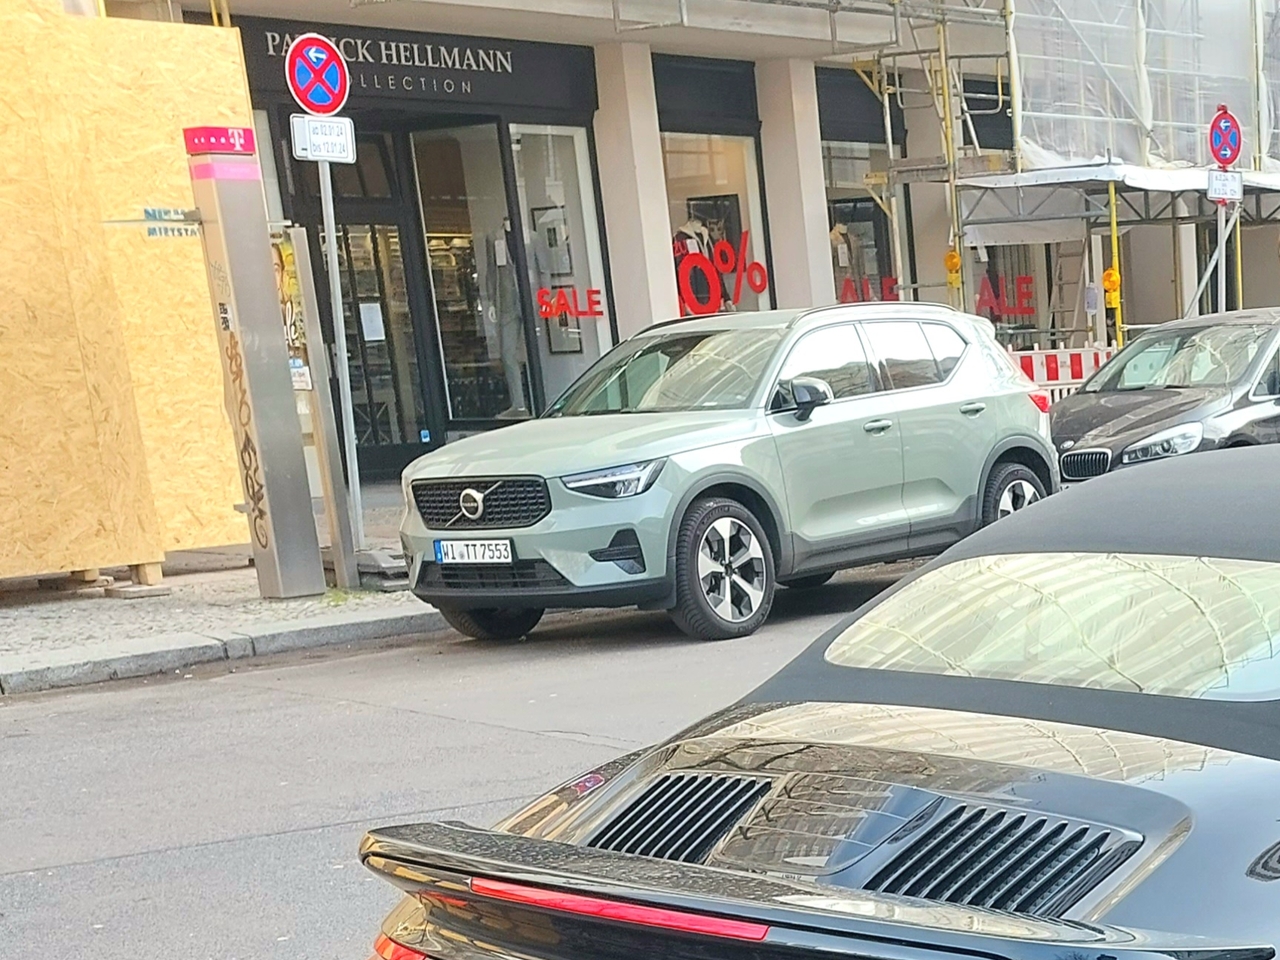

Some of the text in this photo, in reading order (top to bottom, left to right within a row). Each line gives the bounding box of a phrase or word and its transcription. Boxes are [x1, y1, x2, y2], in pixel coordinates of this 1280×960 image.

[380, 41, 513, 74] HELLMANN
[349, 75, 472, 94] LLECTION
[536, 287, 604, 318] SALE
[976, 275, 1035, 315] ALE
[442, 543, 509, 560] WI TT 7553
